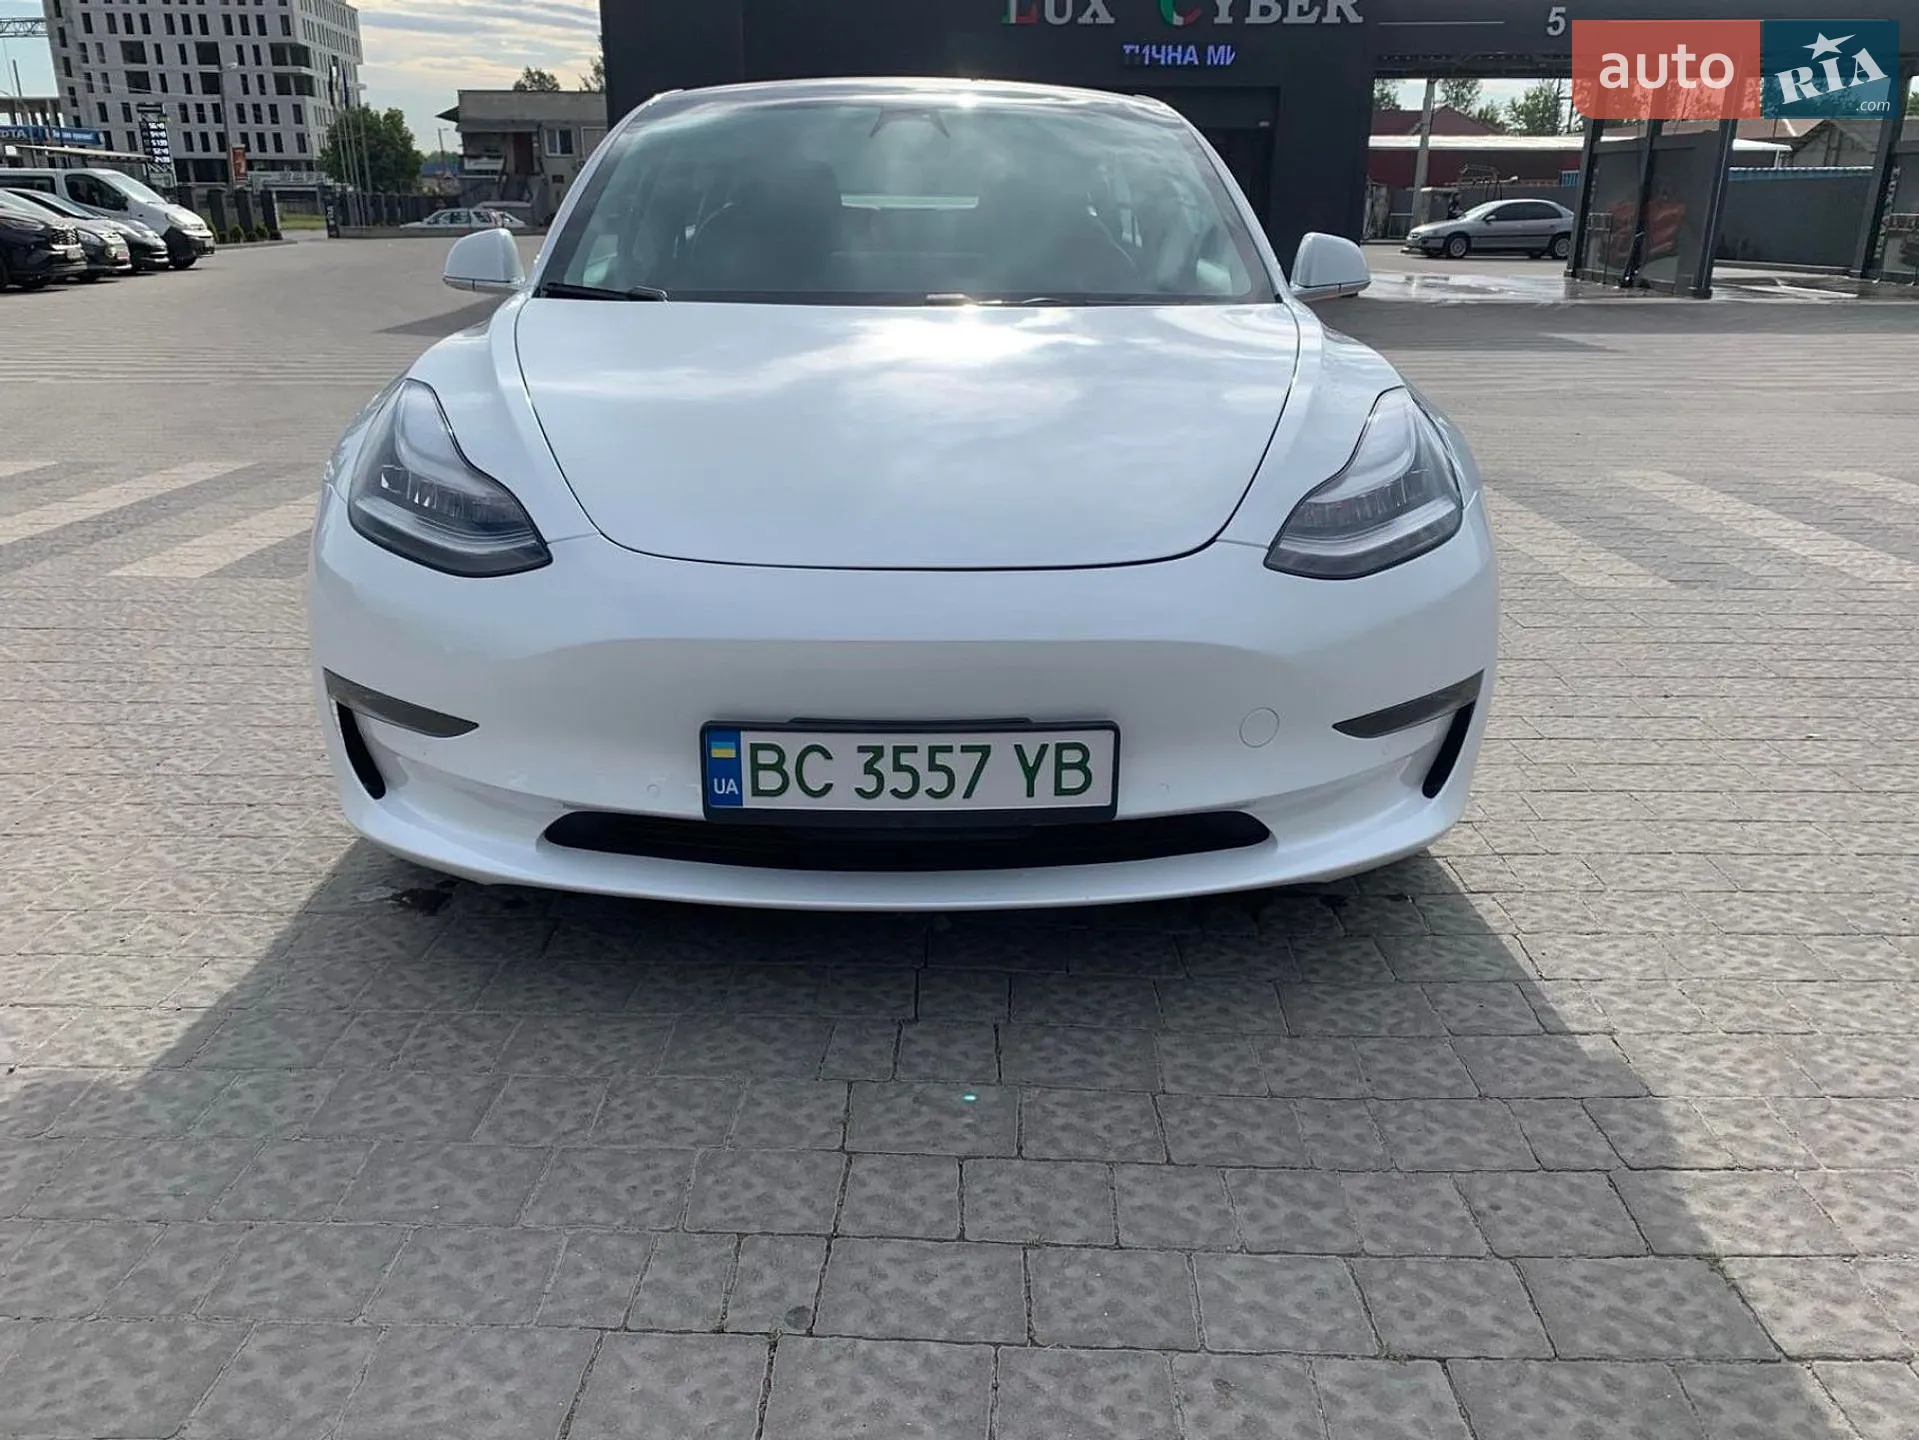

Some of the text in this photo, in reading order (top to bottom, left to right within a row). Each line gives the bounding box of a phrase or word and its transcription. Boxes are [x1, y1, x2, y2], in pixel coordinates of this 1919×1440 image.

[1546, 6, 1567, 36] 5
[748, 741, 1093, 800] BC 3557 YB
[713, 778, 739, 795] UA
